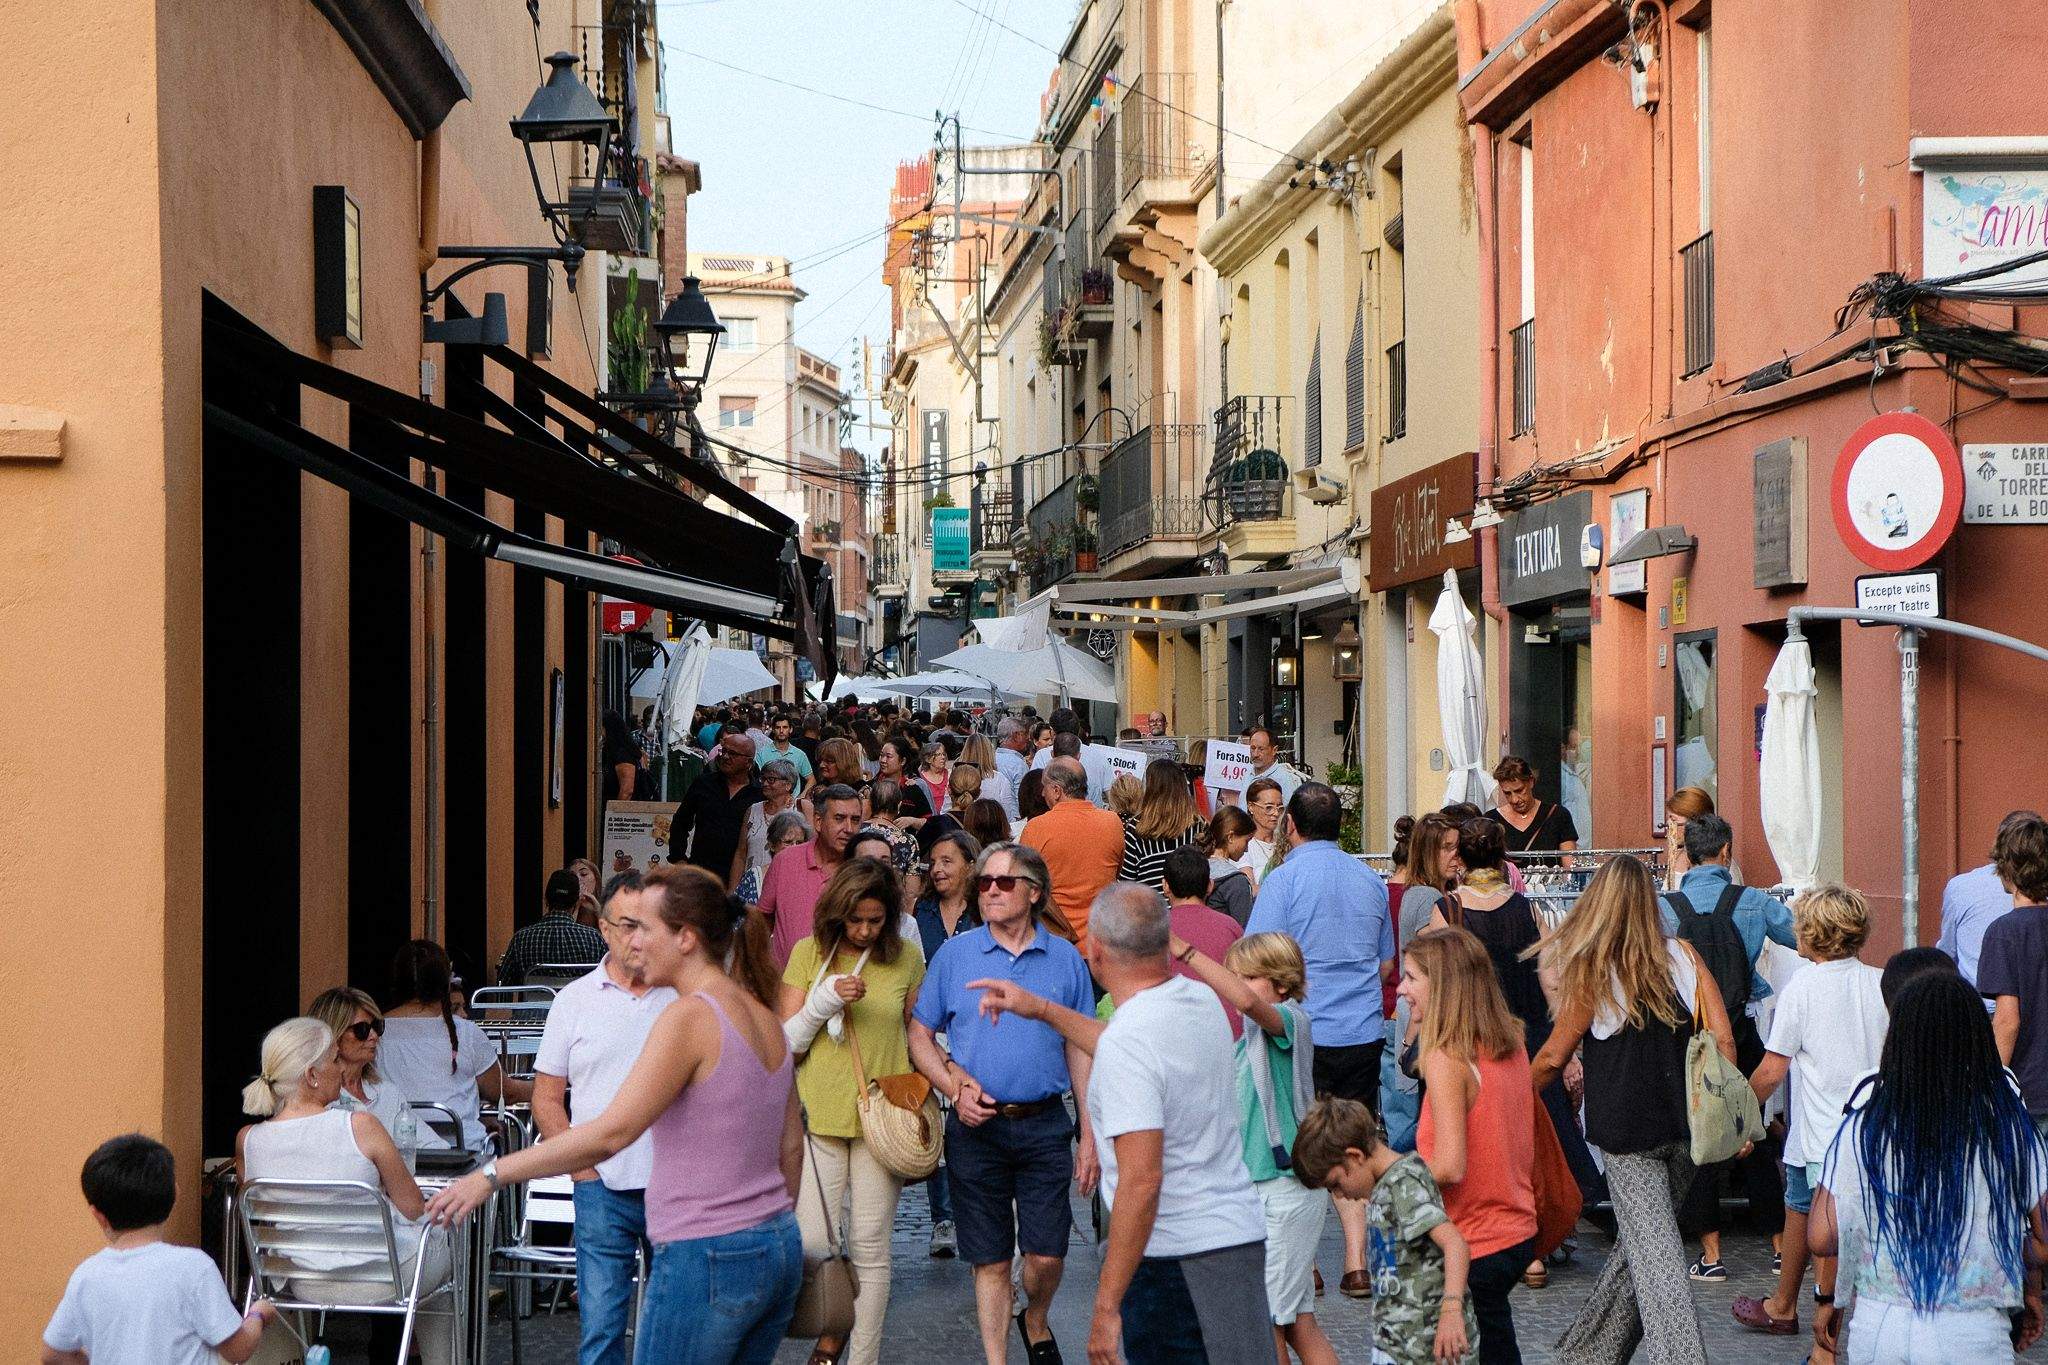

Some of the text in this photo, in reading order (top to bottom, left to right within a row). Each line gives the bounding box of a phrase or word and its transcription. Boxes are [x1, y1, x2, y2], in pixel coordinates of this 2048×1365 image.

[1978, 504, 1994, 518] DE
[2003, 504, 2019, 517] LA
[1515, 523, 1562, 578] TEXTURA
[1864, 582, 1931, 598] Excepte veïns
[1900, 601, 1930, 612] Teatre
[1216, 750, 1235, 762] Fora
[1113, 757, 1137, 770] Stock
